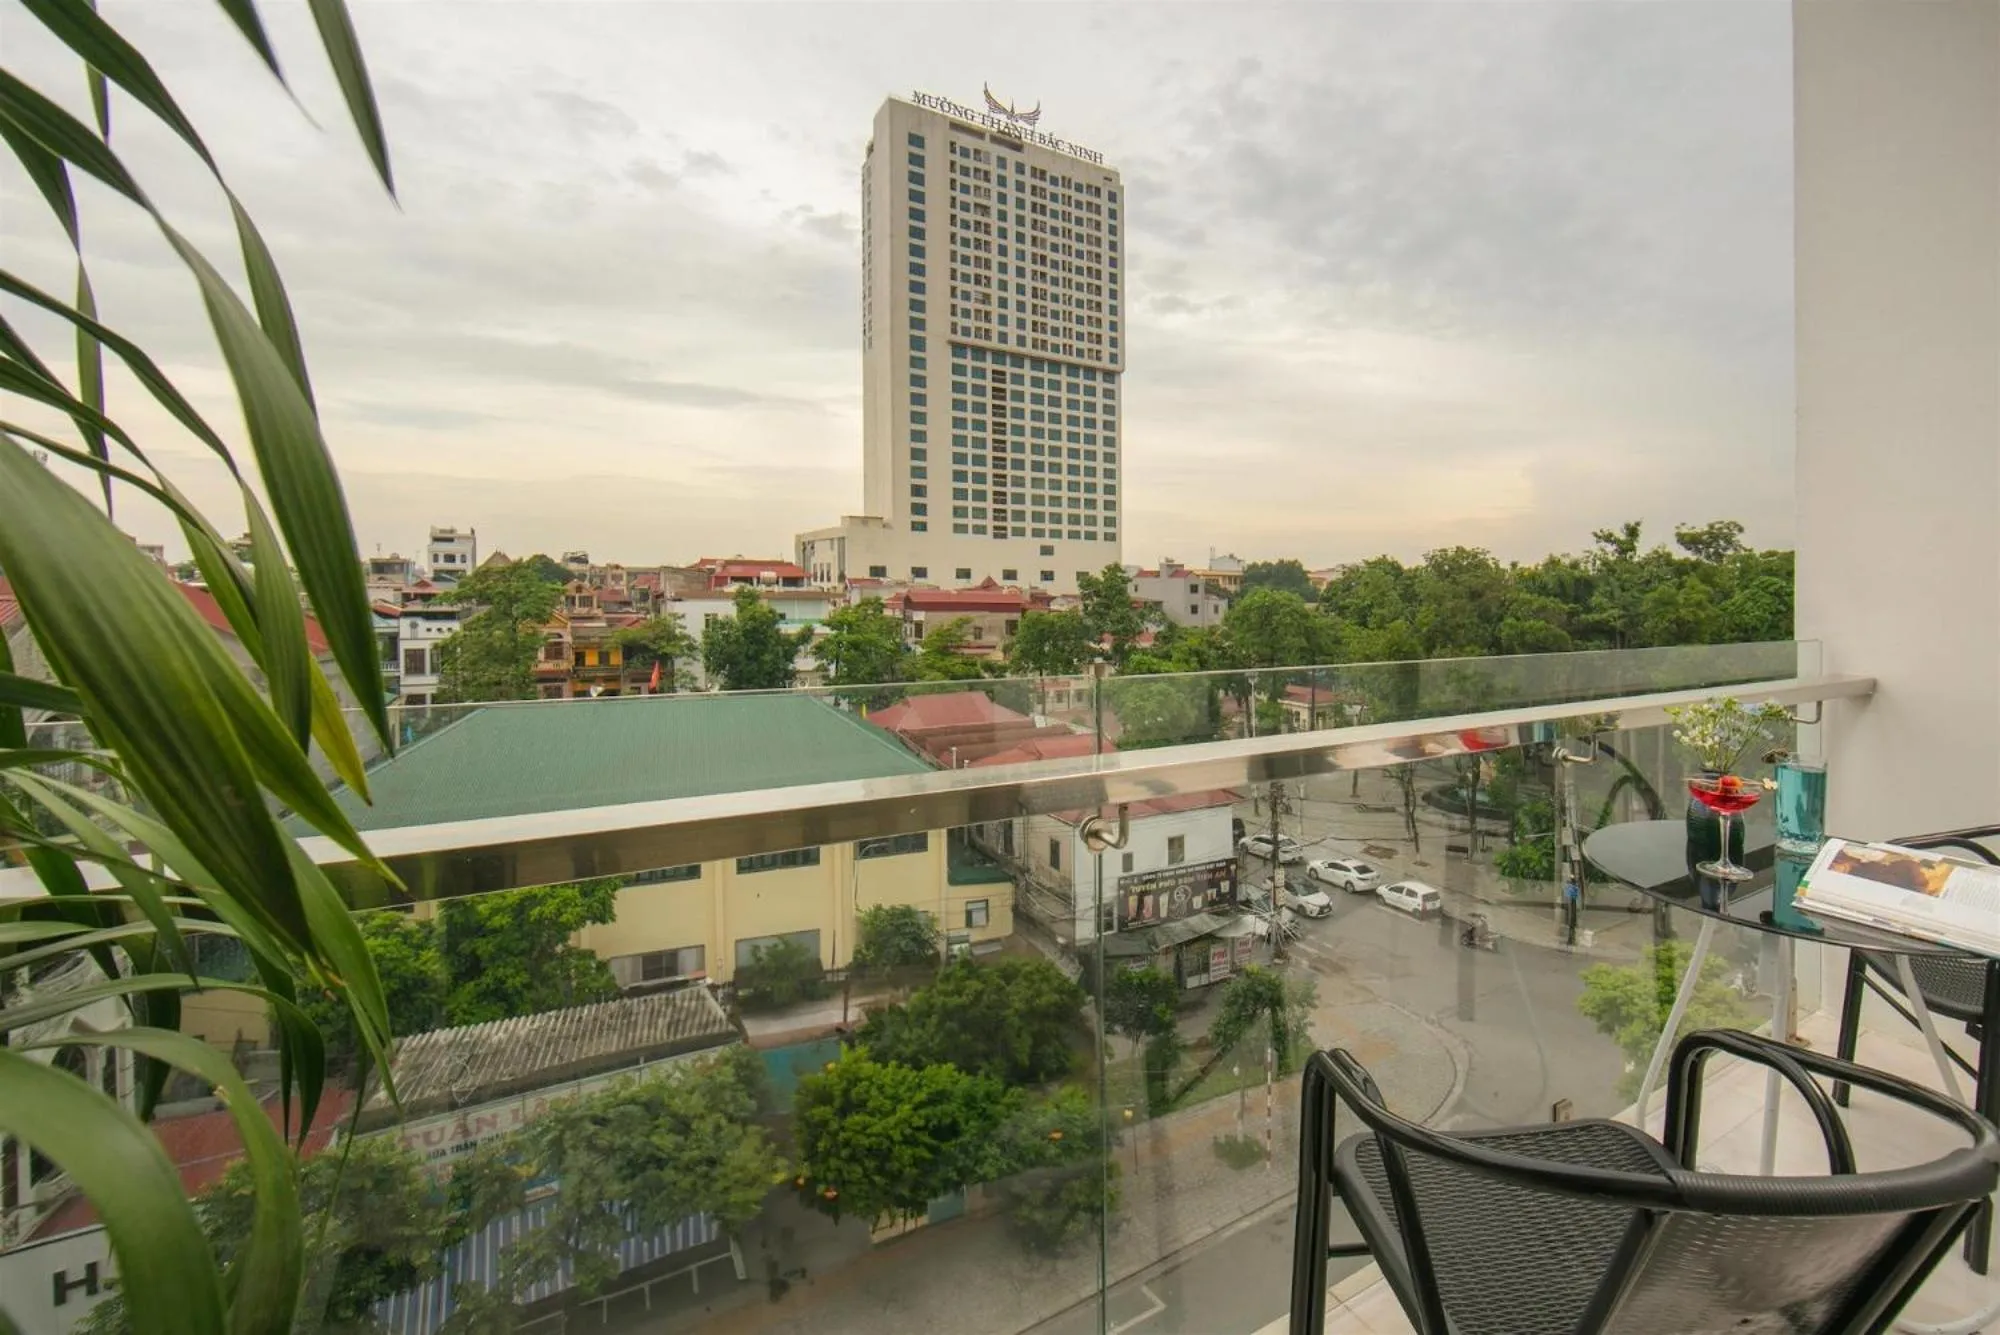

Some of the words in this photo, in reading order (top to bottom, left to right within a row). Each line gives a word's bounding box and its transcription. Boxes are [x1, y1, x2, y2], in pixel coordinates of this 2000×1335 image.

[912, 90, 976, 121] MƯỜNG
[1039, 131, 1065, 152] BẮC
[1068, 144, 1104, 164] NINH
